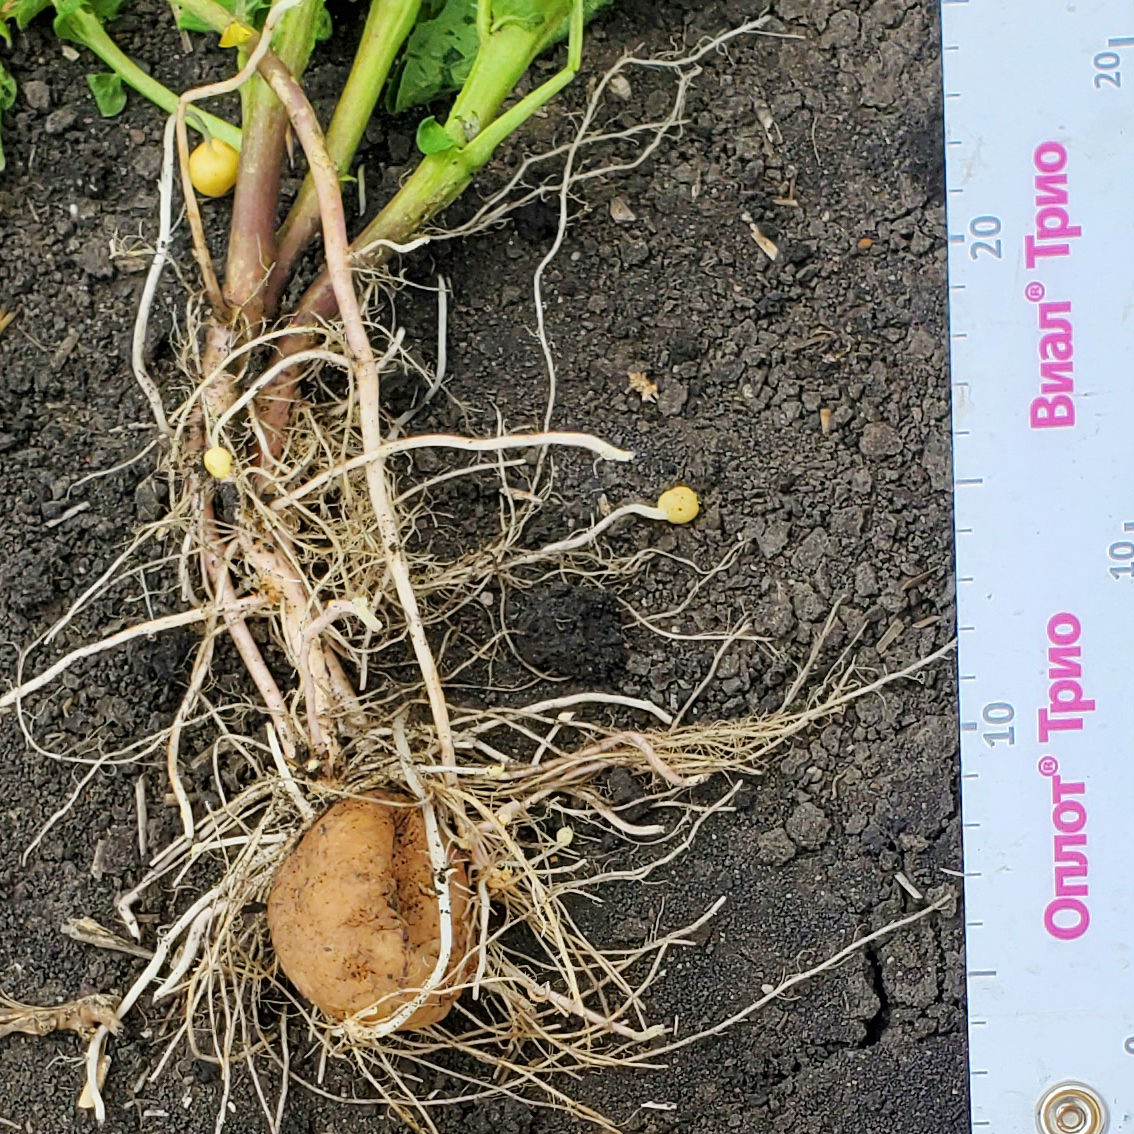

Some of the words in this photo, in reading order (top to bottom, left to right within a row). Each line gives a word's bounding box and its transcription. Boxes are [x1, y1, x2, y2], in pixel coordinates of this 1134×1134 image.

[1093, 50, 1122, 89] 20
[1024, 140, 1082, 269] Трио
[969, 214, 1002, 261] 20
[1038, 611, 1096, 743] Трио
[982, 701, 1016, 748] 10
